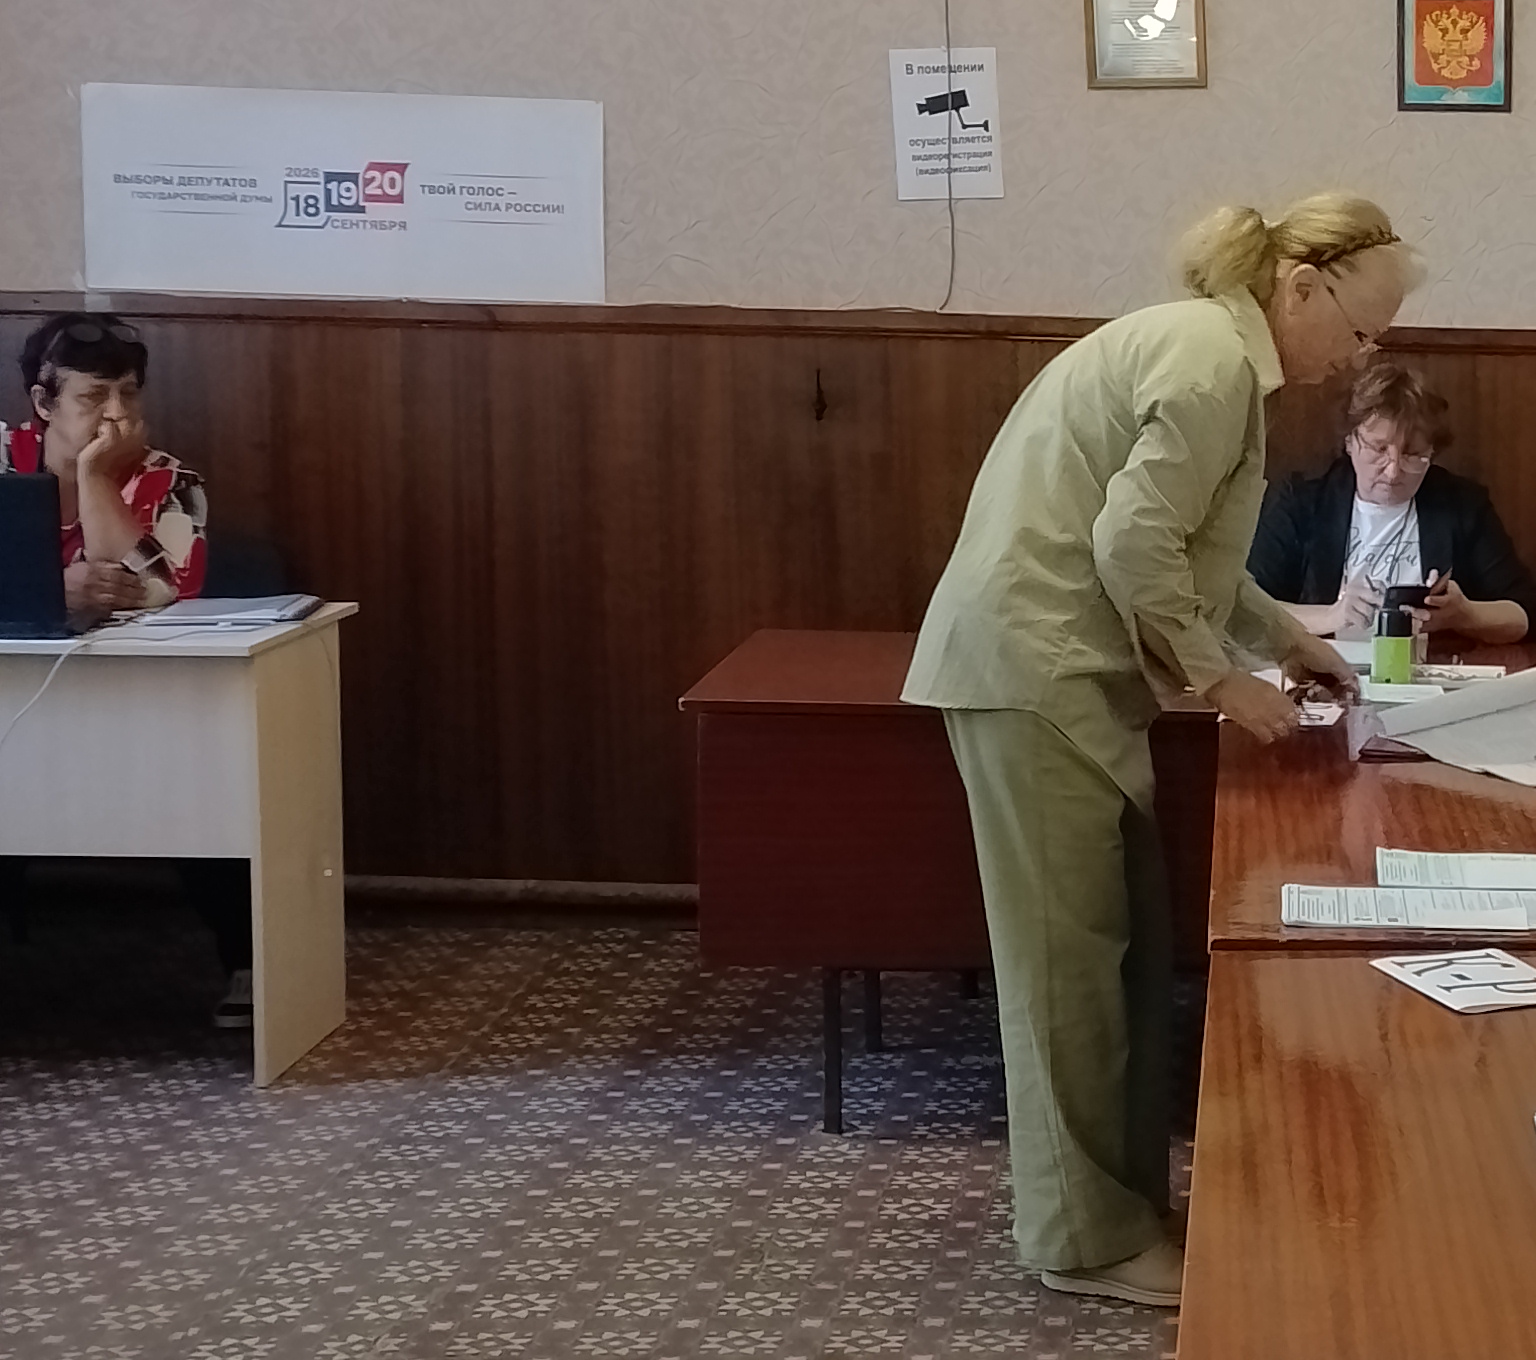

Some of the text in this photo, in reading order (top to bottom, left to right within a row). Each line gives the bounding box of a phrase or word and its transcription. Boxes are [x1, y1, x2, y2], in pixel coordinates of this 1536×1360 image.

[905, 63, 914, 75] В
[908, 135, 993, 148] осущесвляется
[284, 166, 319, 178] 2026
[113, 173, 257, 189] ВЫБОРЫ ДЕПУТАТОВ
[290, 170, 402, 218] 18 19 20
[419, 183, 456, 195] ТВОЙ
[459, 185, 505, 197] ГОЛОС
[464, 201, 565, 214] СИЛА РОССИИ!
[330, 218, 408, 231] СЕНТЯБРЯ
